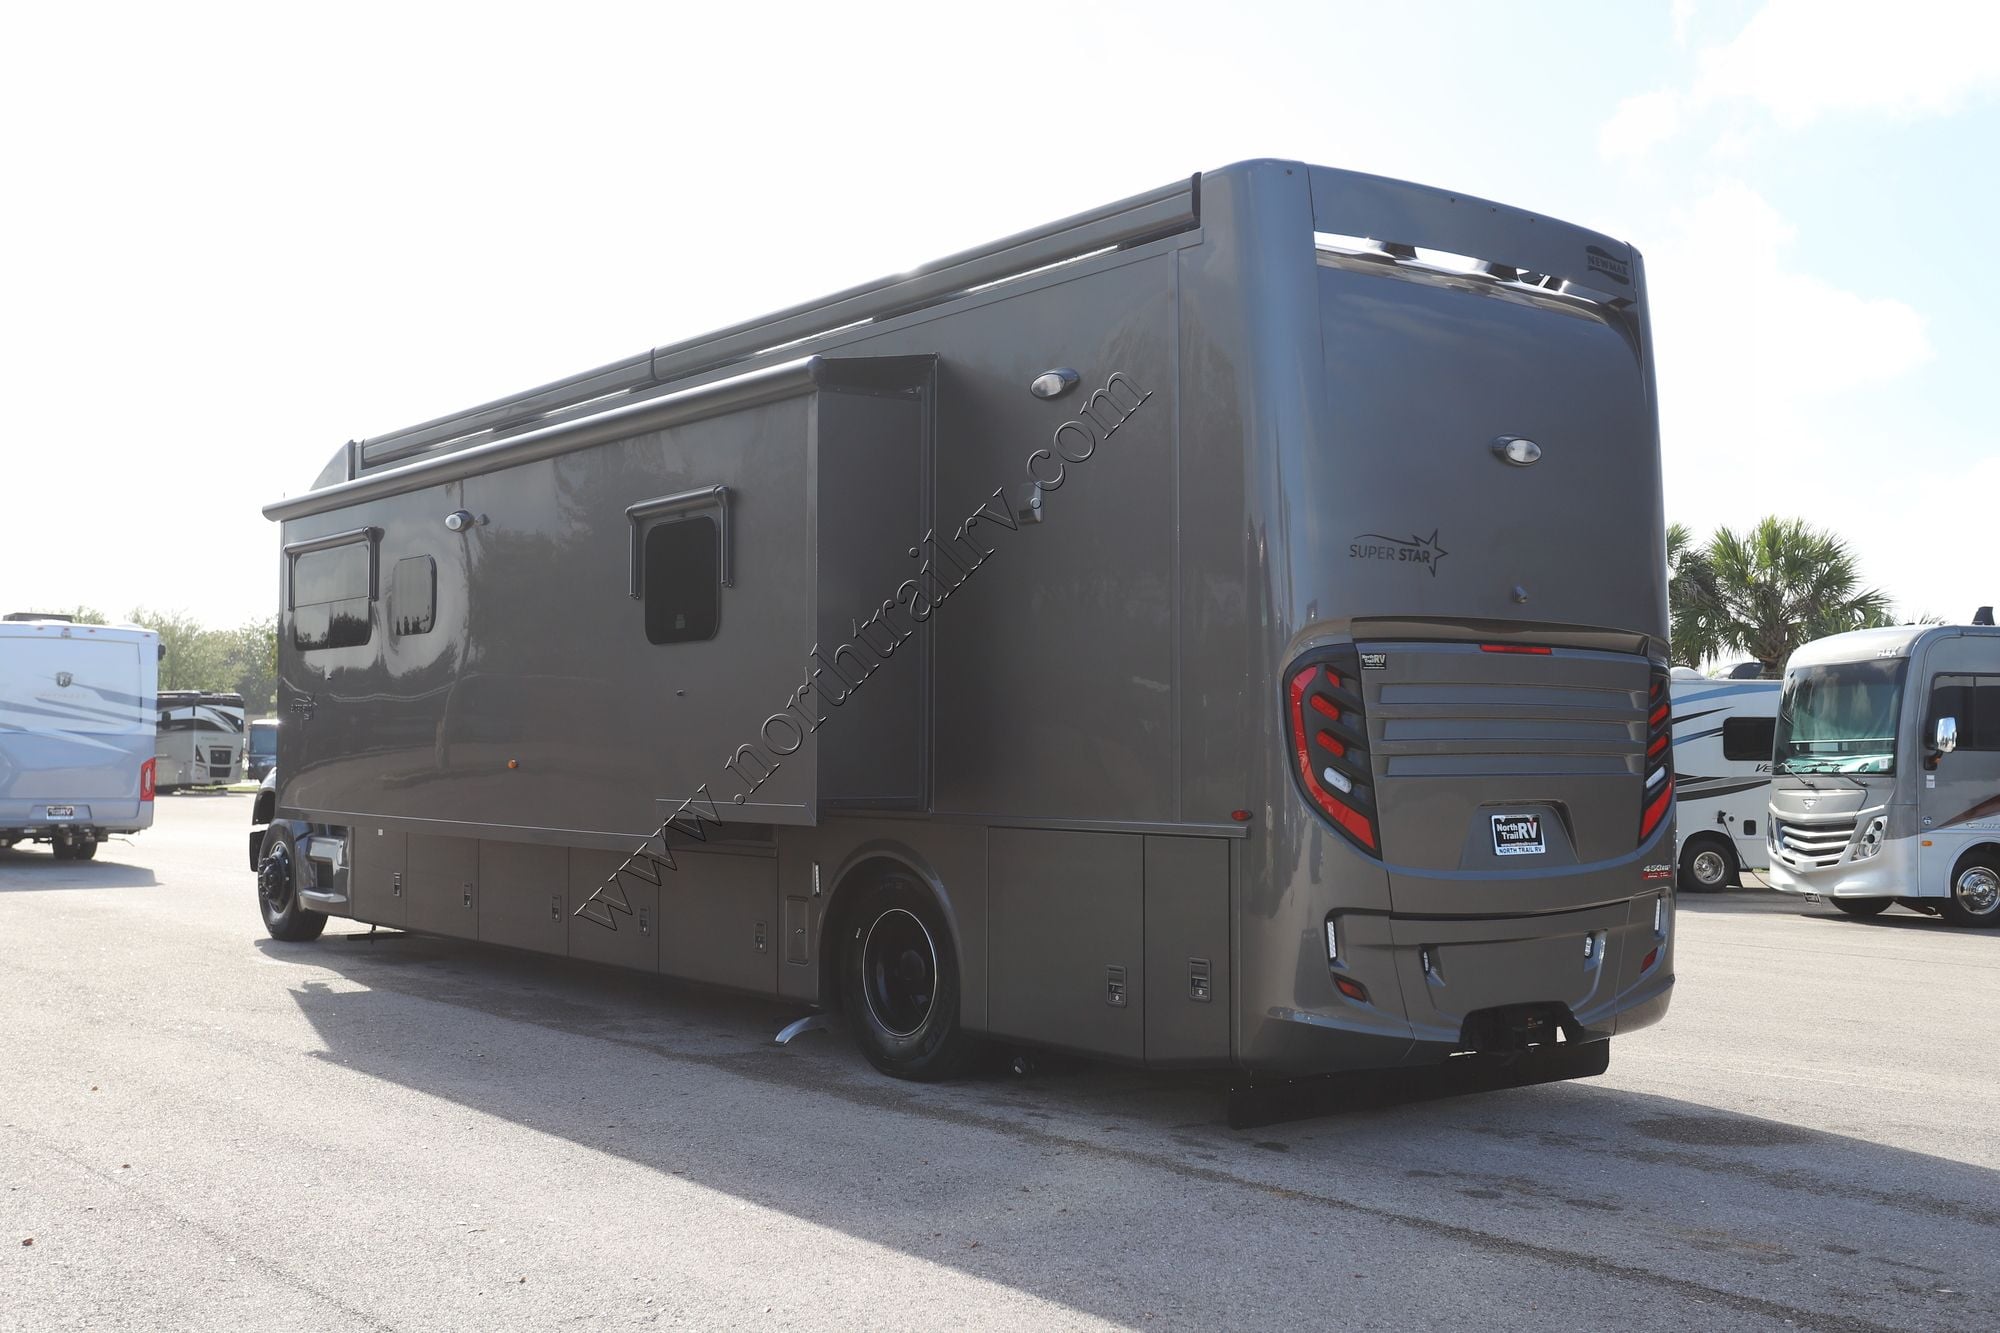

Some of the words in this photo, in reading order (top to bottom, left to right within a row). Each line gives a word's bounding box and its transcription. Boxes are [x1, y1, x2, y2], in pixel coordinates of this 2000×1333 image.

[1349, 544, 1395, 560] SUPER
[1399, 548, 1430, 563] STAR
[1496, 823, 1518, 831] North
[1518, 822, 1538, 839] RV
